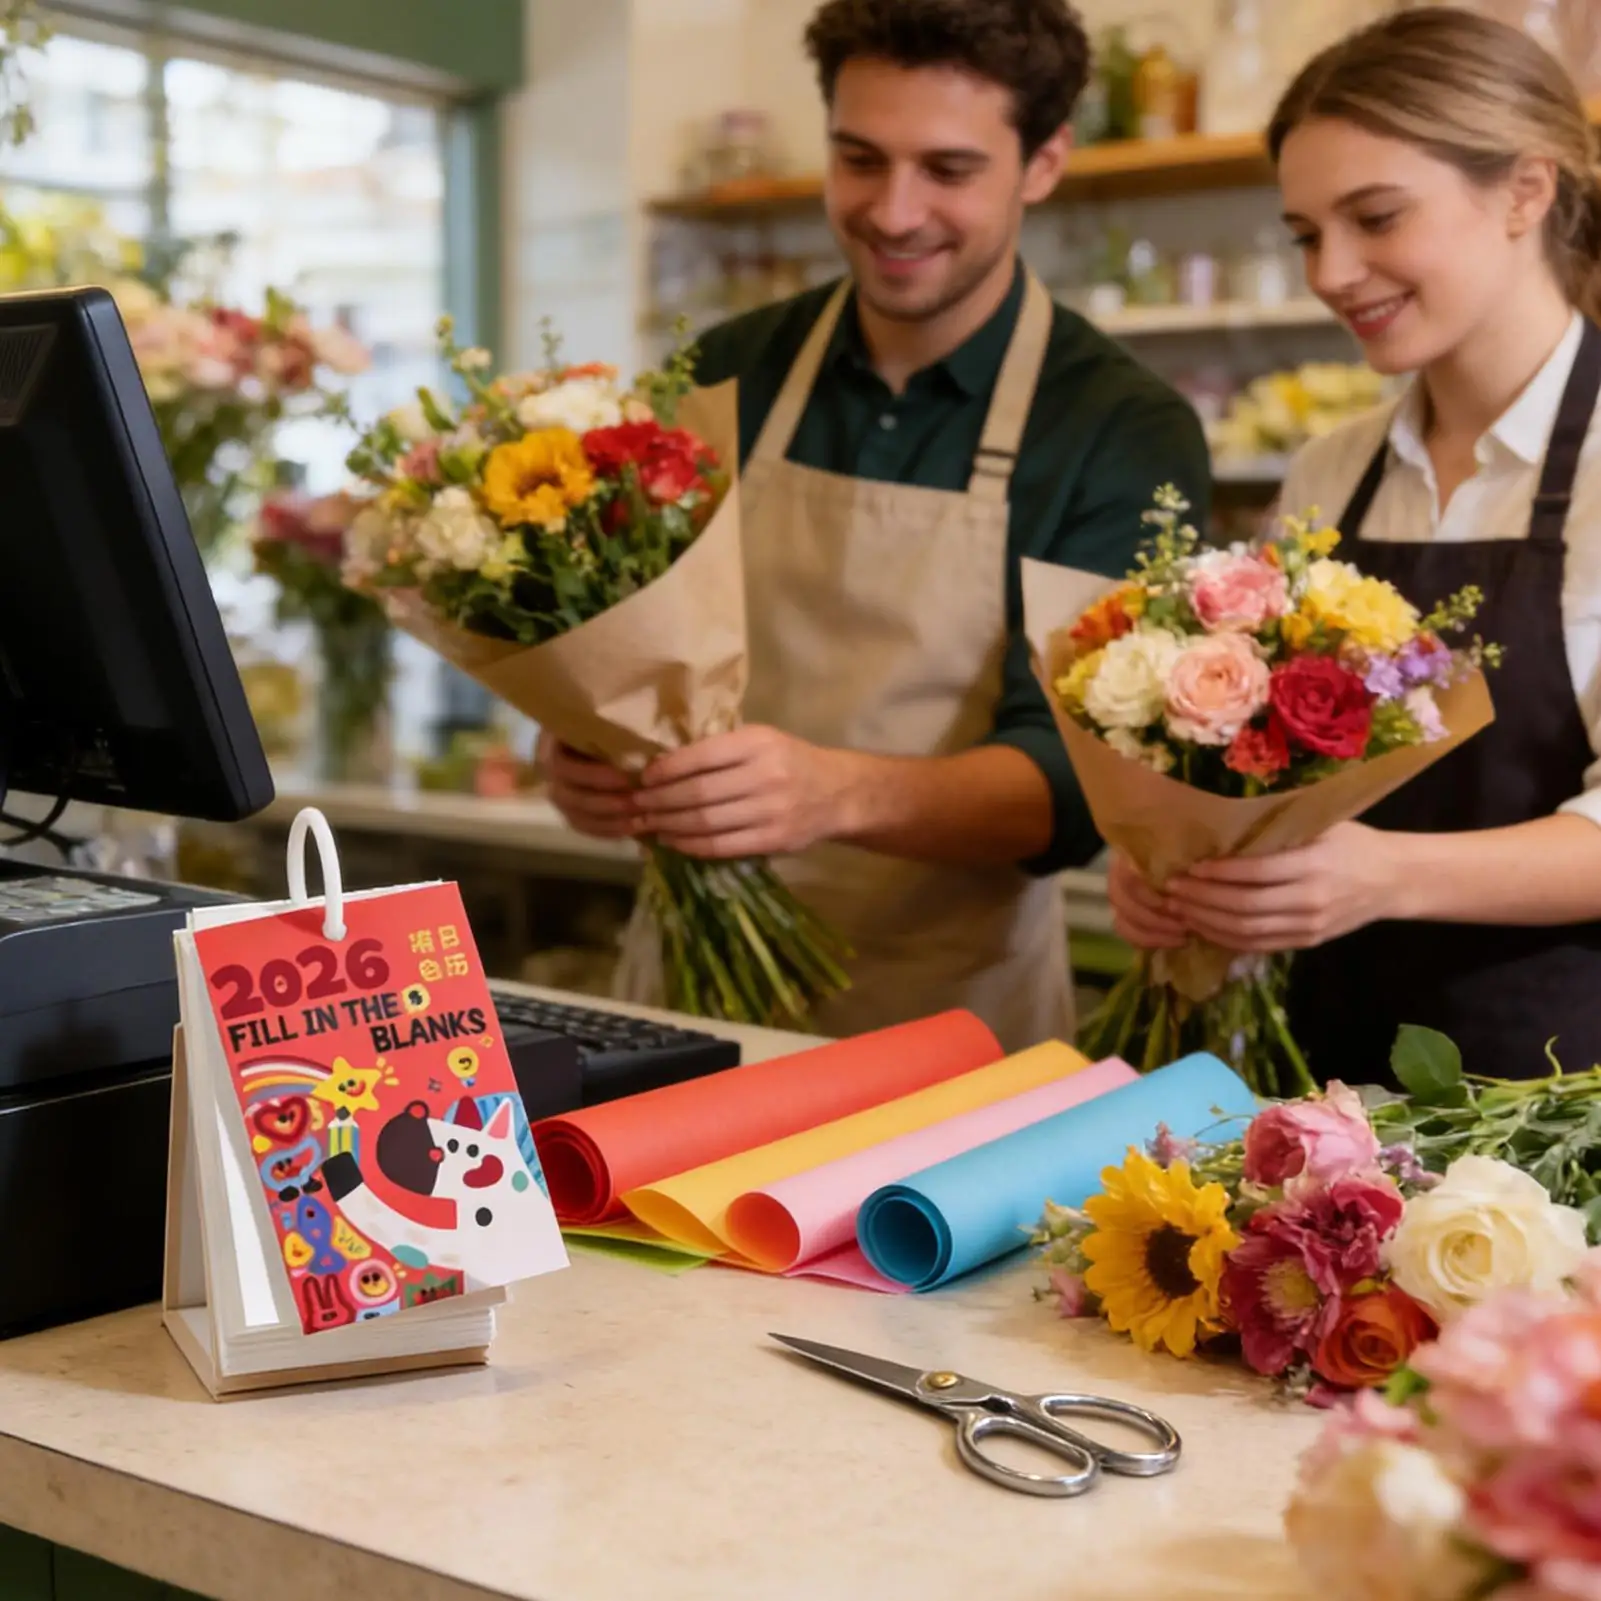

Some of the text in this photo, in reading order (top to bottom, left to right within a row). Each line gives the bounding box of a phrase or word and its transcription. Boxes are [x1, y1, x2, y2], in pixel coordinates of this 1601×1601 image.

[209, 938, 390, 1020] 2026
[227, 993, 402, 1053] FILL IN THE
[370, 1008, 486, 1054] BLANKS
